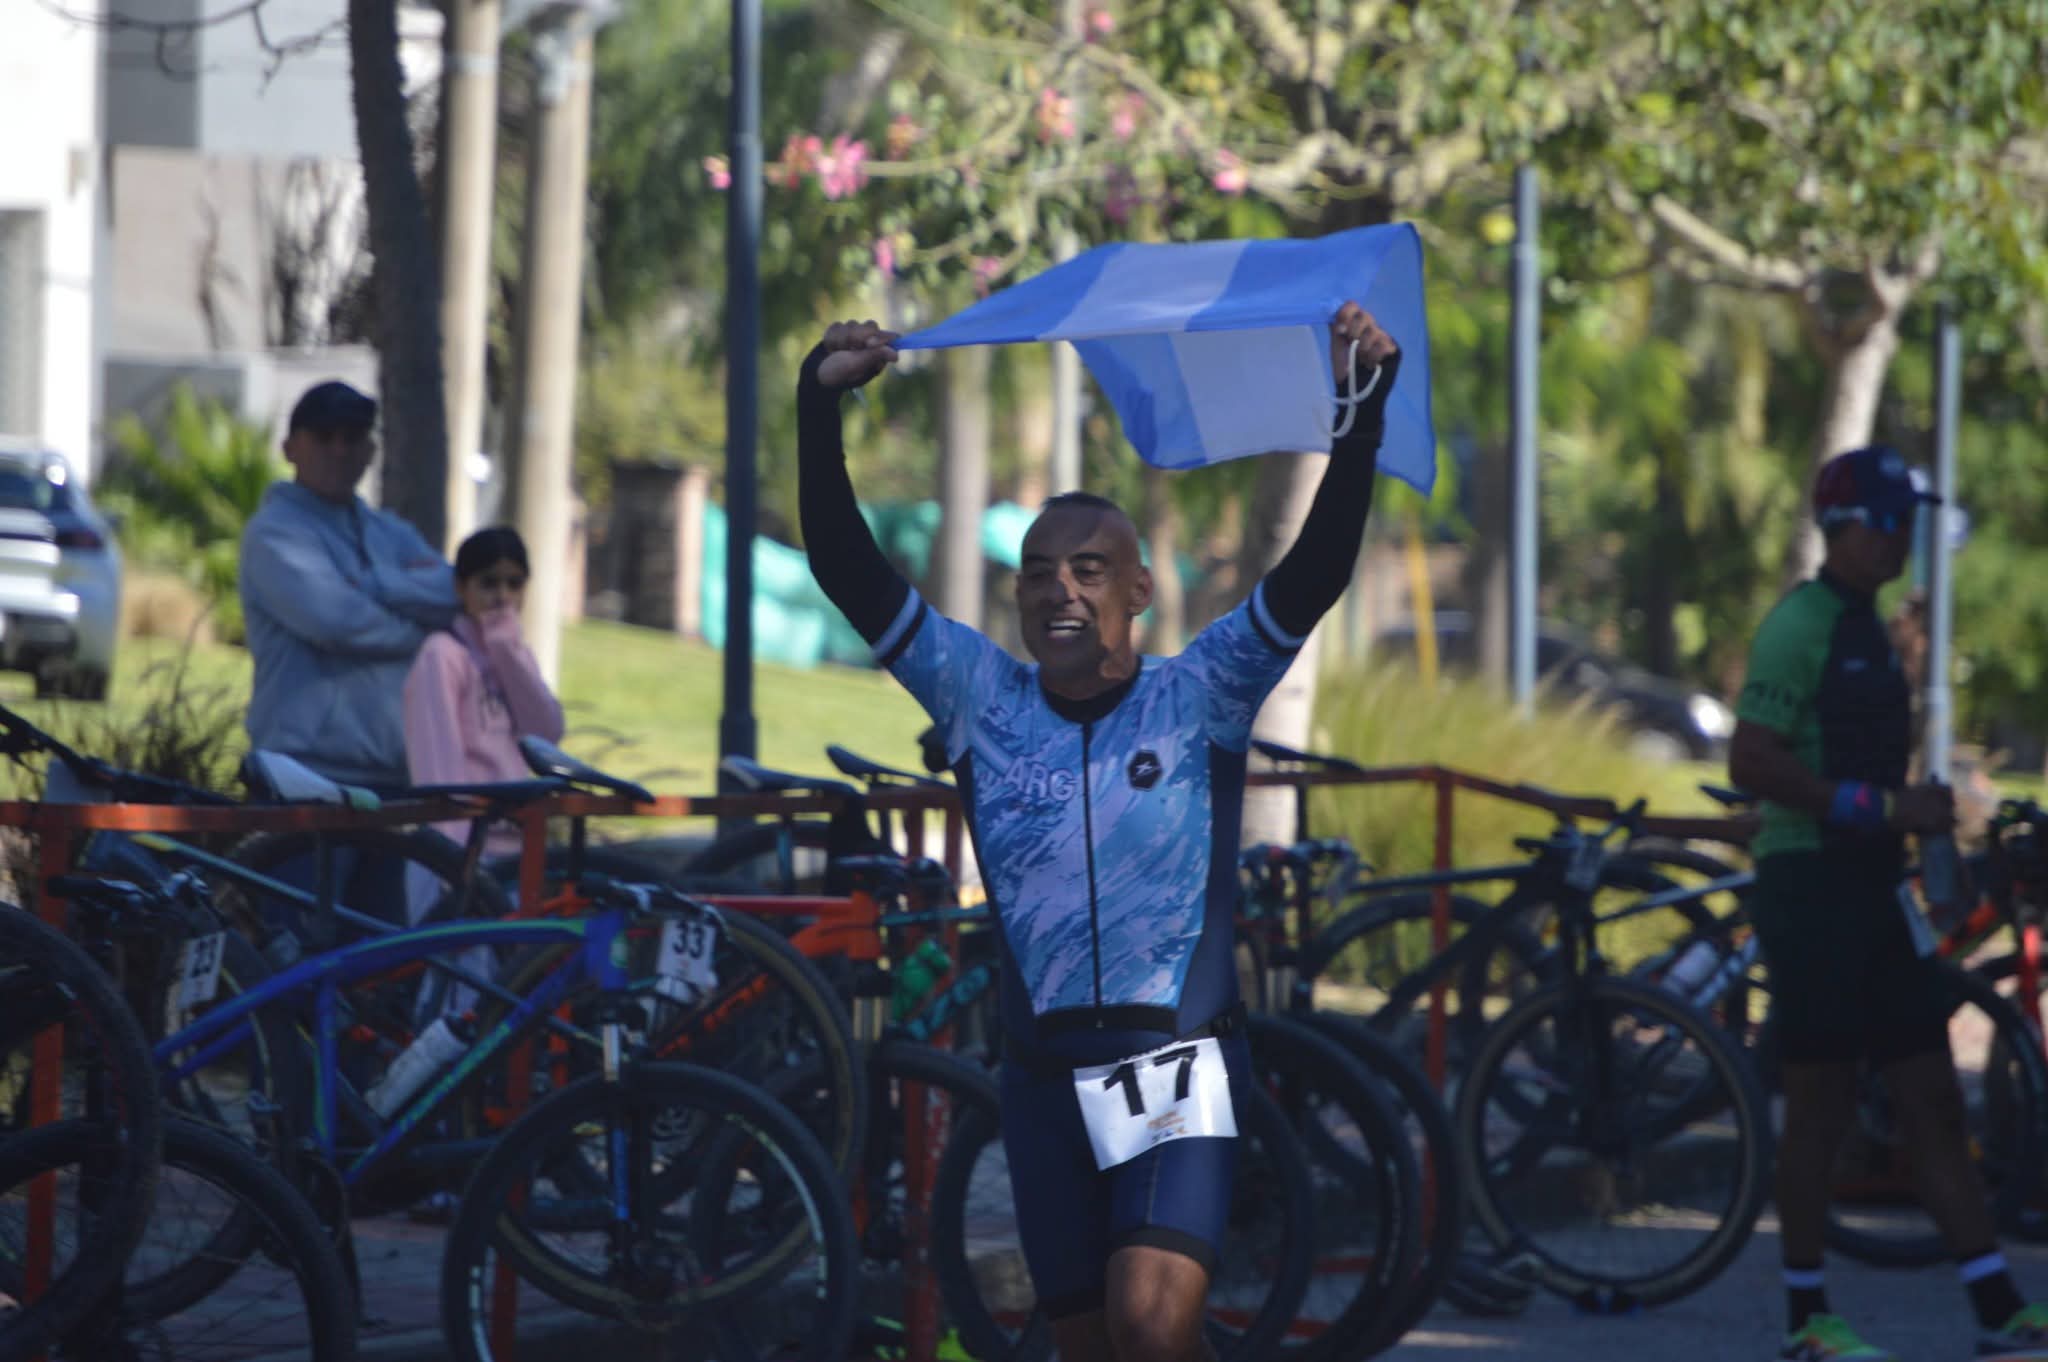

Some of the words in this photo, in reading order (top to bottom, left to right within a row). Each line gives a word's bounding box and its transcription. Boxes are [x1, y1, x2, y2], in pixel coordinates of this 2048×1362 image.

[1005, 755, 1076, 802] ARG
[674, 919, 704, 959] 33
[1102, 1045, 1198, 1118] 17
